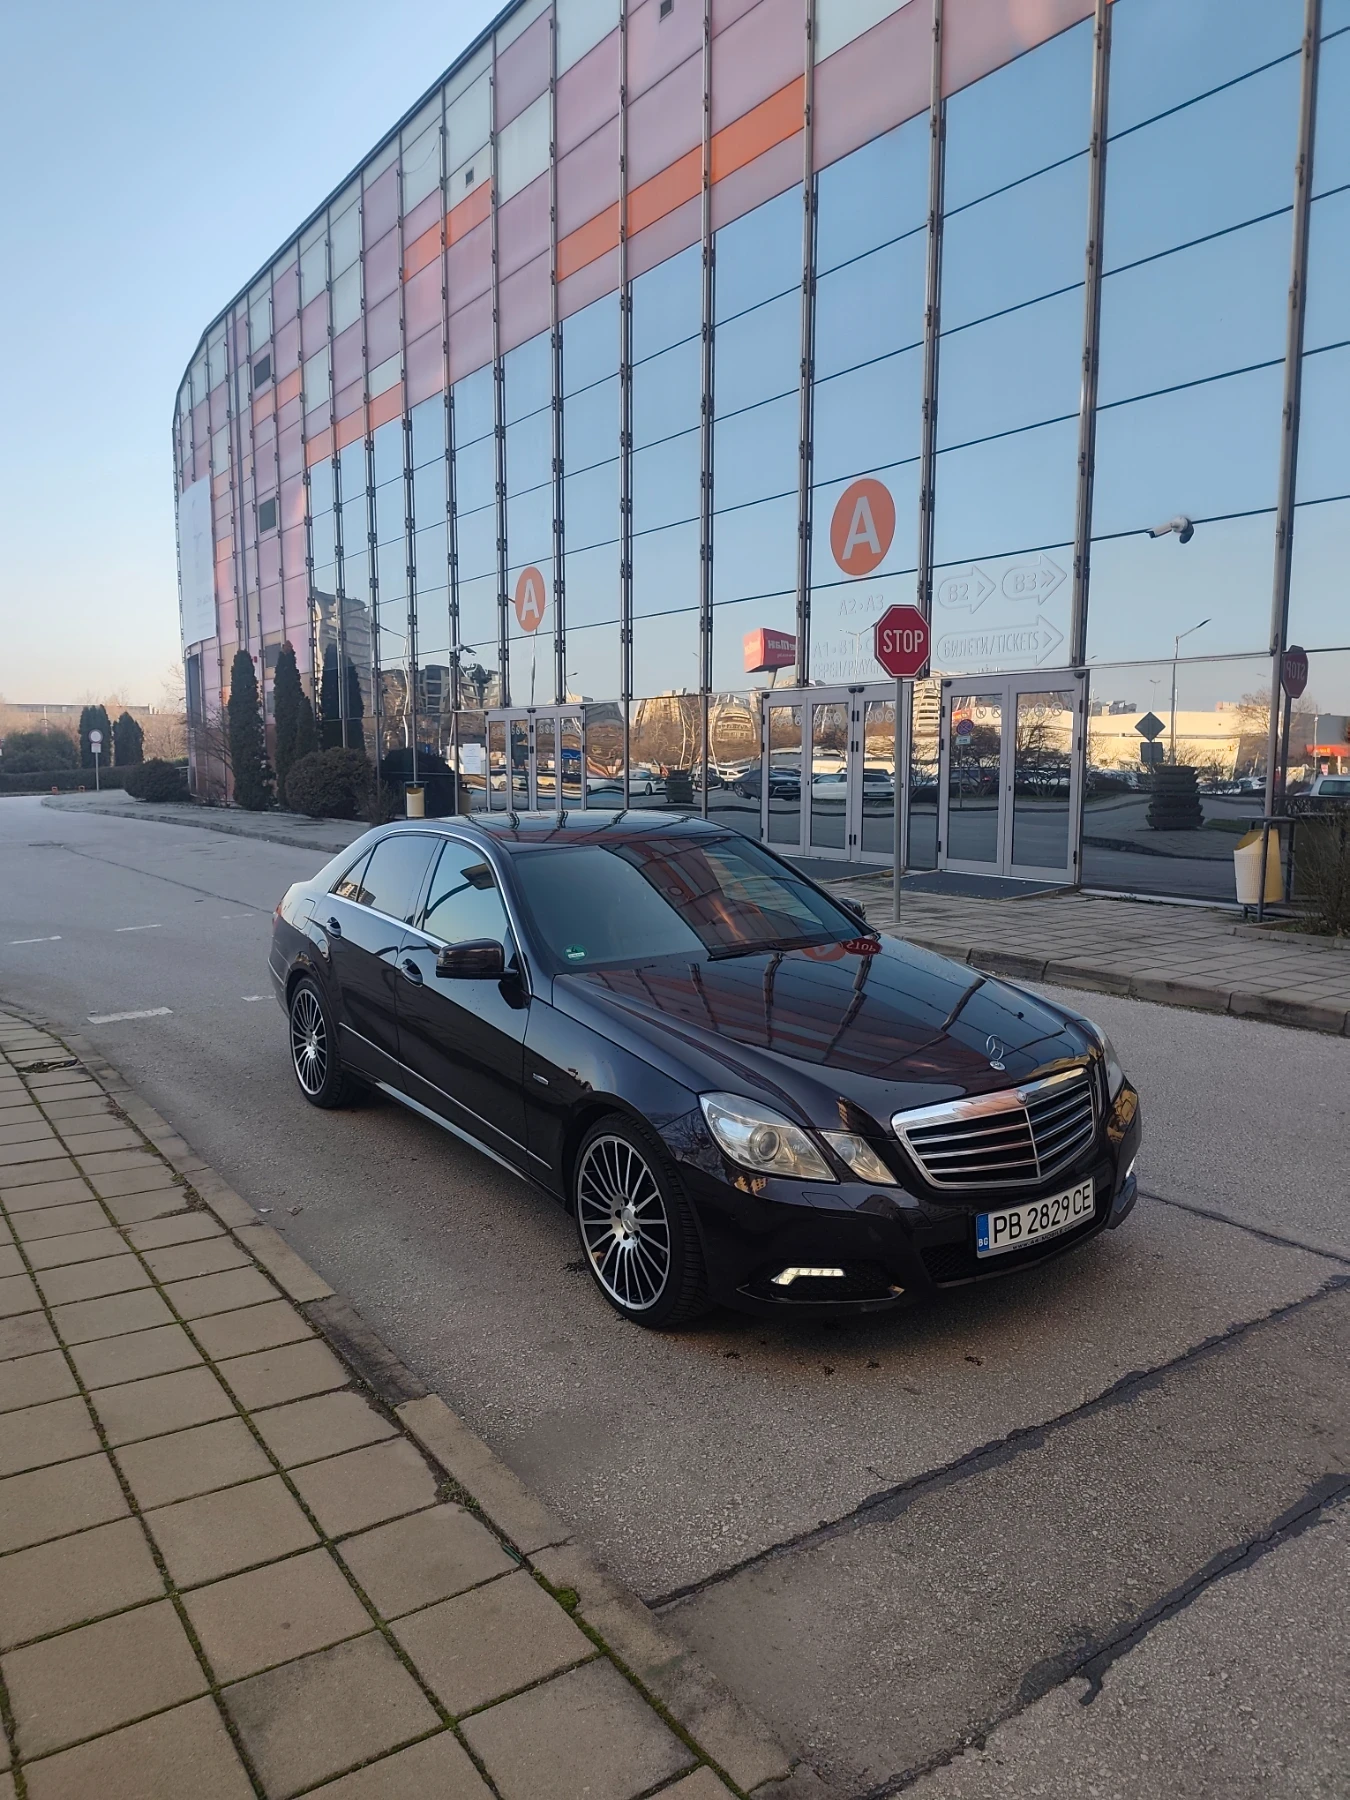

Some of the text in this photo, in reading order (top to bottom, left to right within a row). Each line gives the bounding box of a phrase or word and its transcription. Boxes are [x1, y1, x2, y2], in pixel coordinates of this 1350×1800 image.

[842, 496, 881, 560] A
[948, 583, 969, 602] B2
[1013, 572, 1037, 593] B3
[521, 578, 540, 621] A
[883, 629, 924, 653] STOP
[993, 1184, 1091, 1244] PB 2829 CE
[978, 1238, 989, 1247] BG
